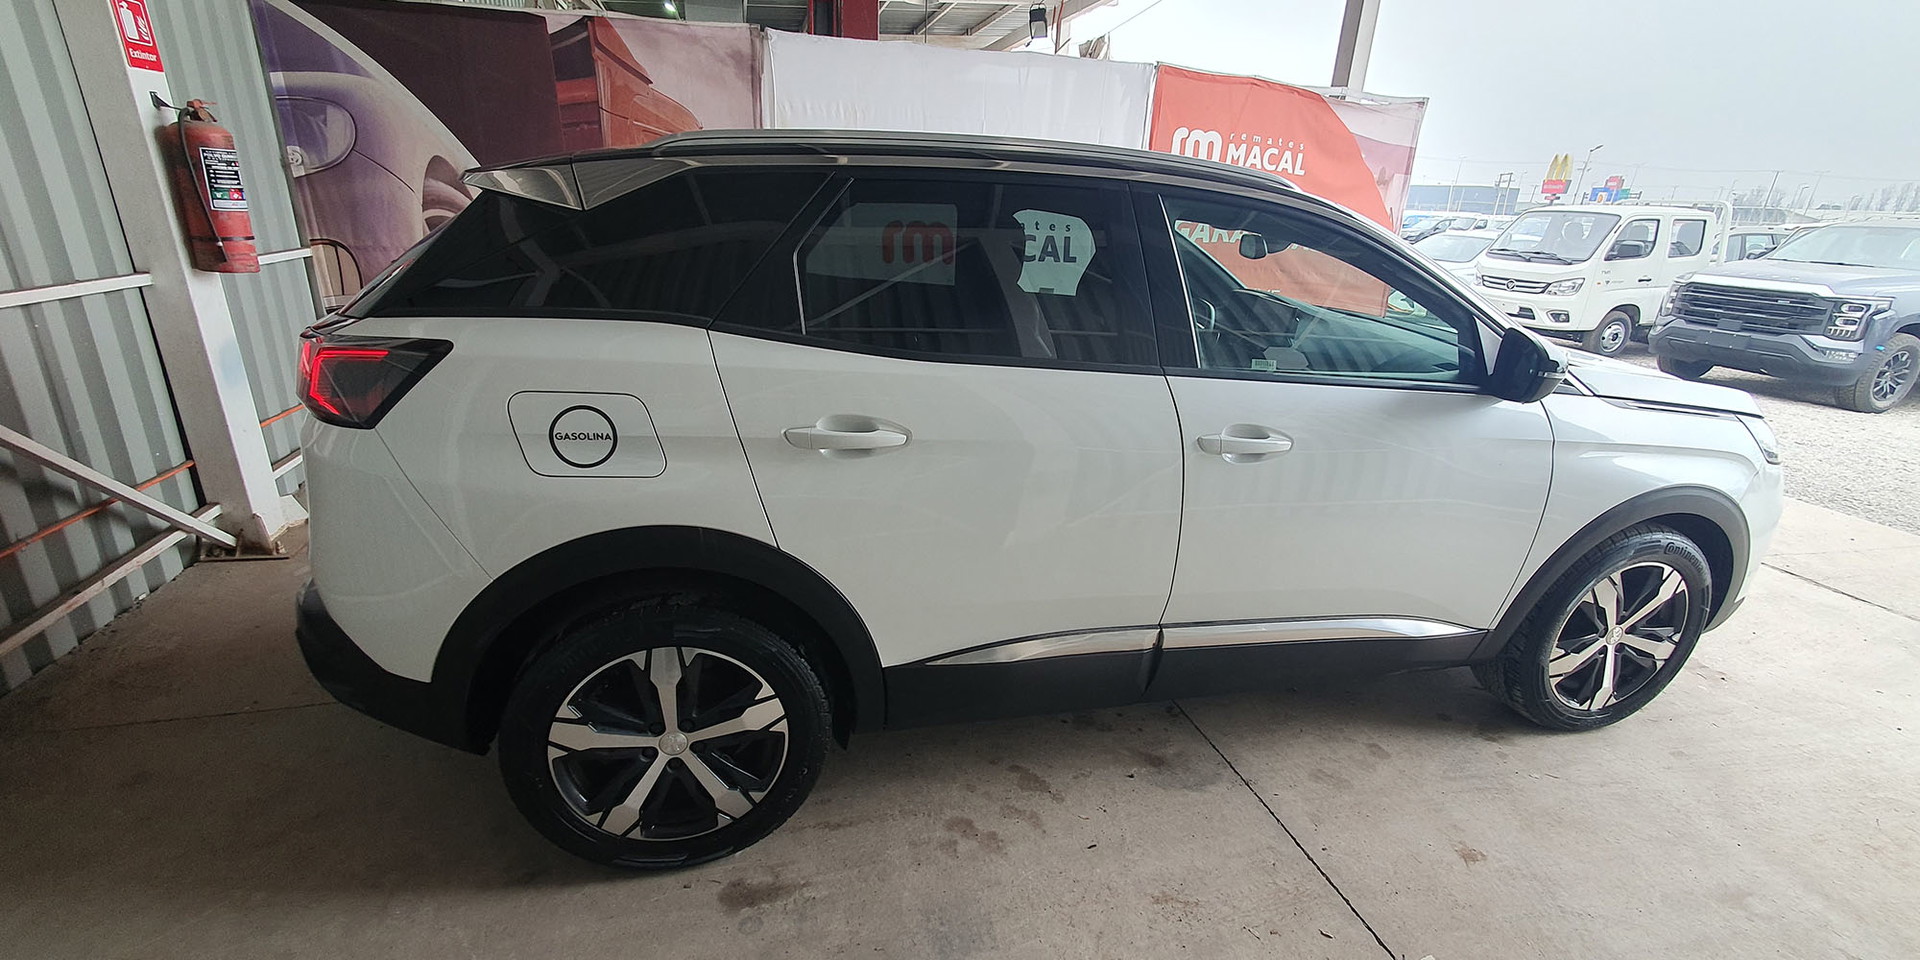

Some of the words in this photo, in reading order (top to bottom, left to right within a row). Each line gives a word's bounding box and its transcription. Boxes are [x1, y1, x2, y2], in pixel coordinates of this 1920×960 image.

[1230, 133, 1304, 150] remates
[1226, 143, 1305, 176] MACAL
[554, 432, 612, 441] GASOLINA
